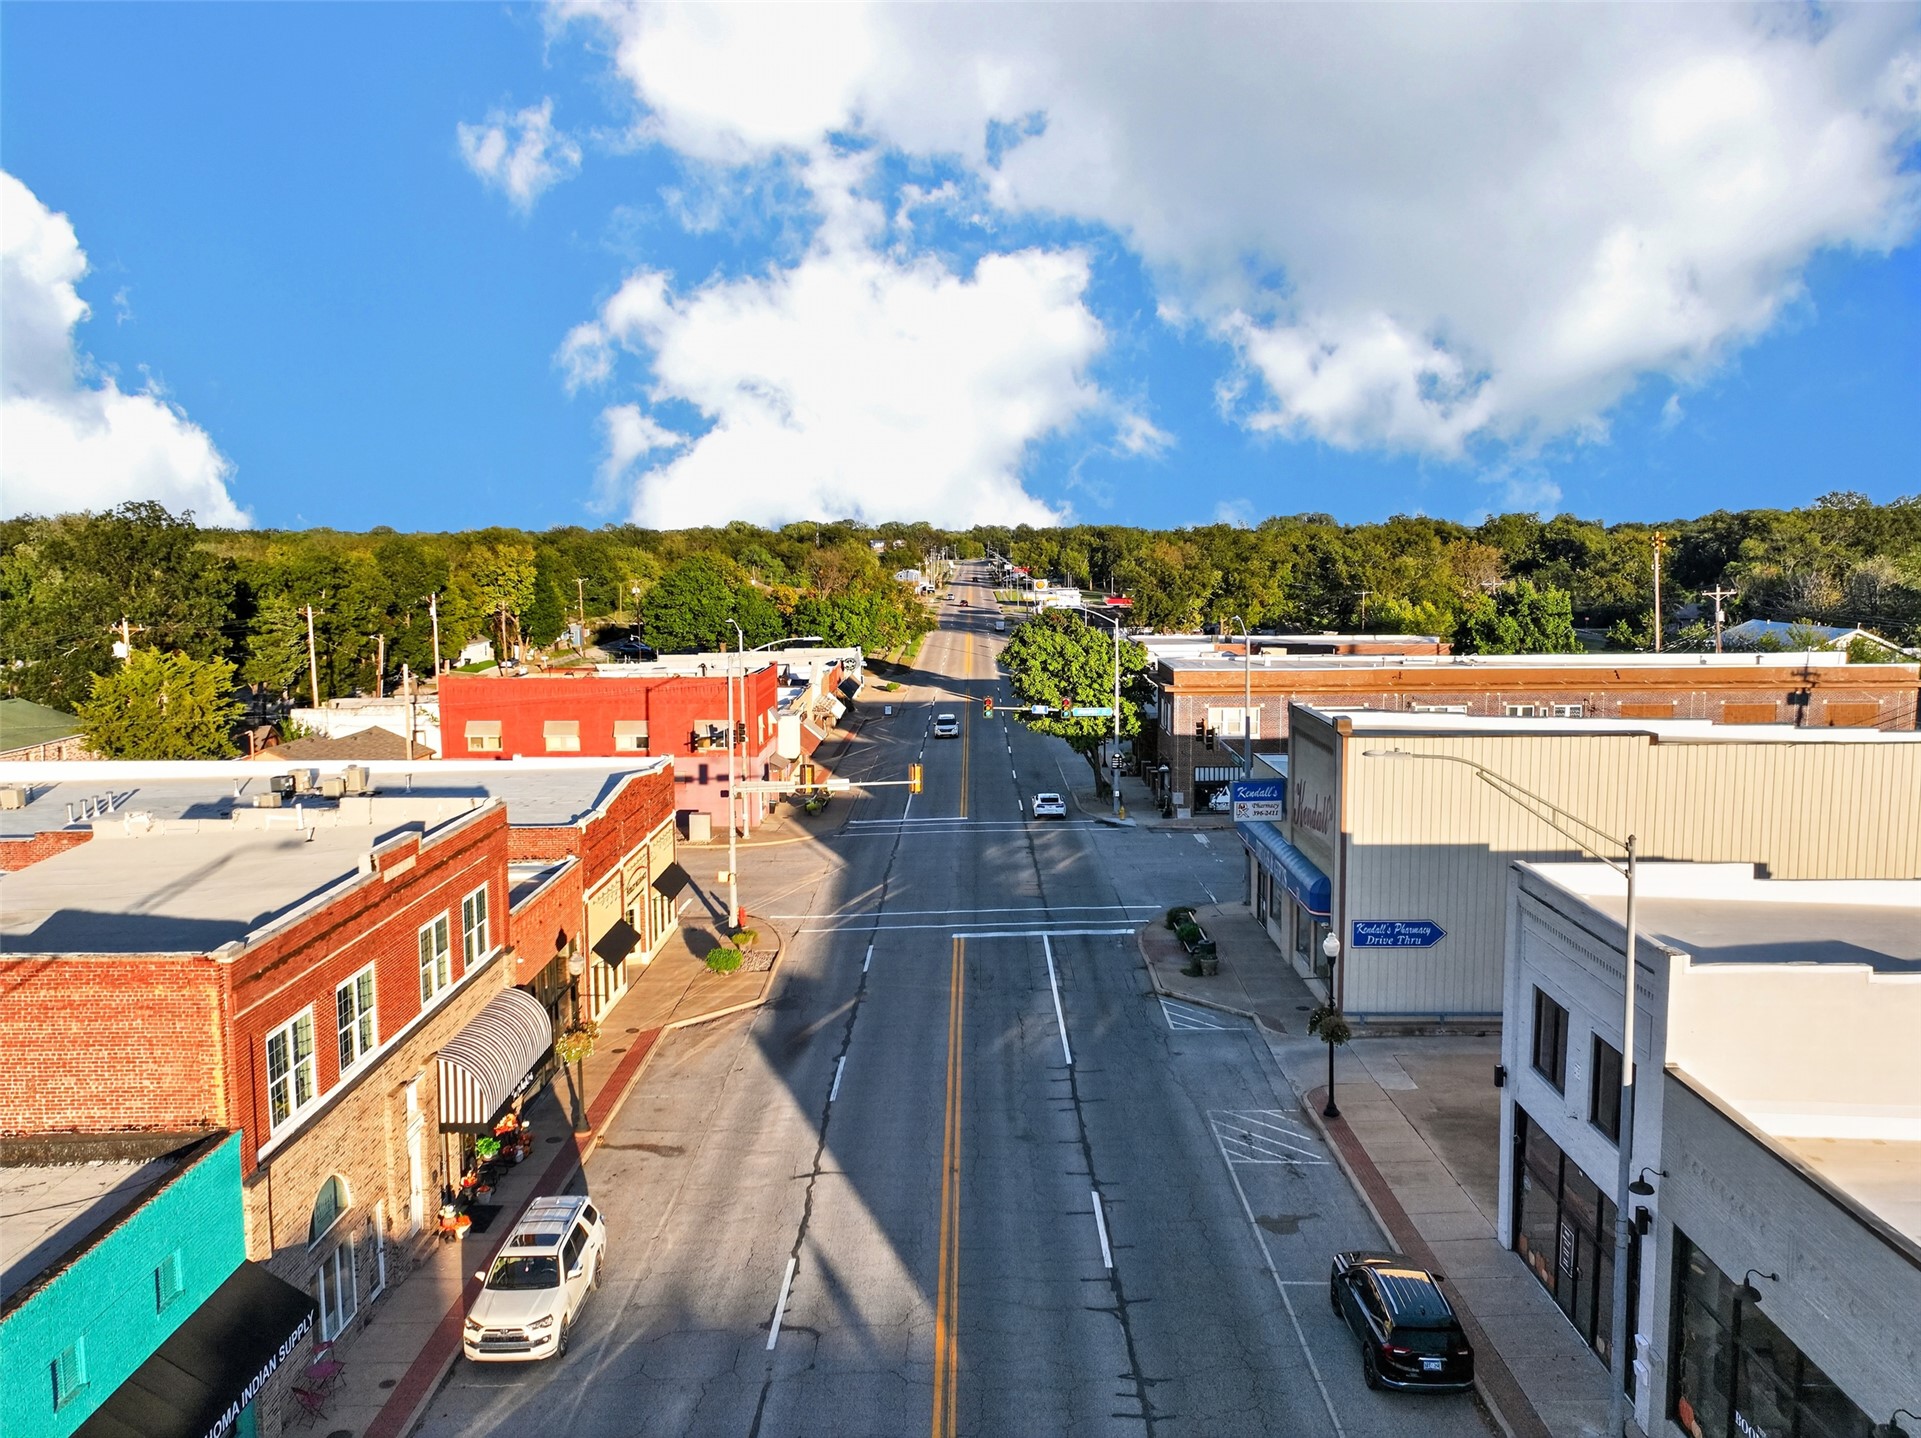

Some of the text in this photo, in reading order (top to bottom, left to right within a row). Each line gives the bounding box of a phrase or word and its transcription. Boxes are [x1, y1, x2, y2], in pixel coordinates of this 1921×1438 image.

[1236, 785, 1278, 798] Kendall's
[1251, 802, 1280, 810] Pharmacy
[1356, 922, 1431, 936] Kendall's Pharmacy
[1365, 935, 1422, 945] Drive Thru
[241, 1354, 277, 1408] INDIAN
[278, 1309, 314, 1362] SUPPLY
